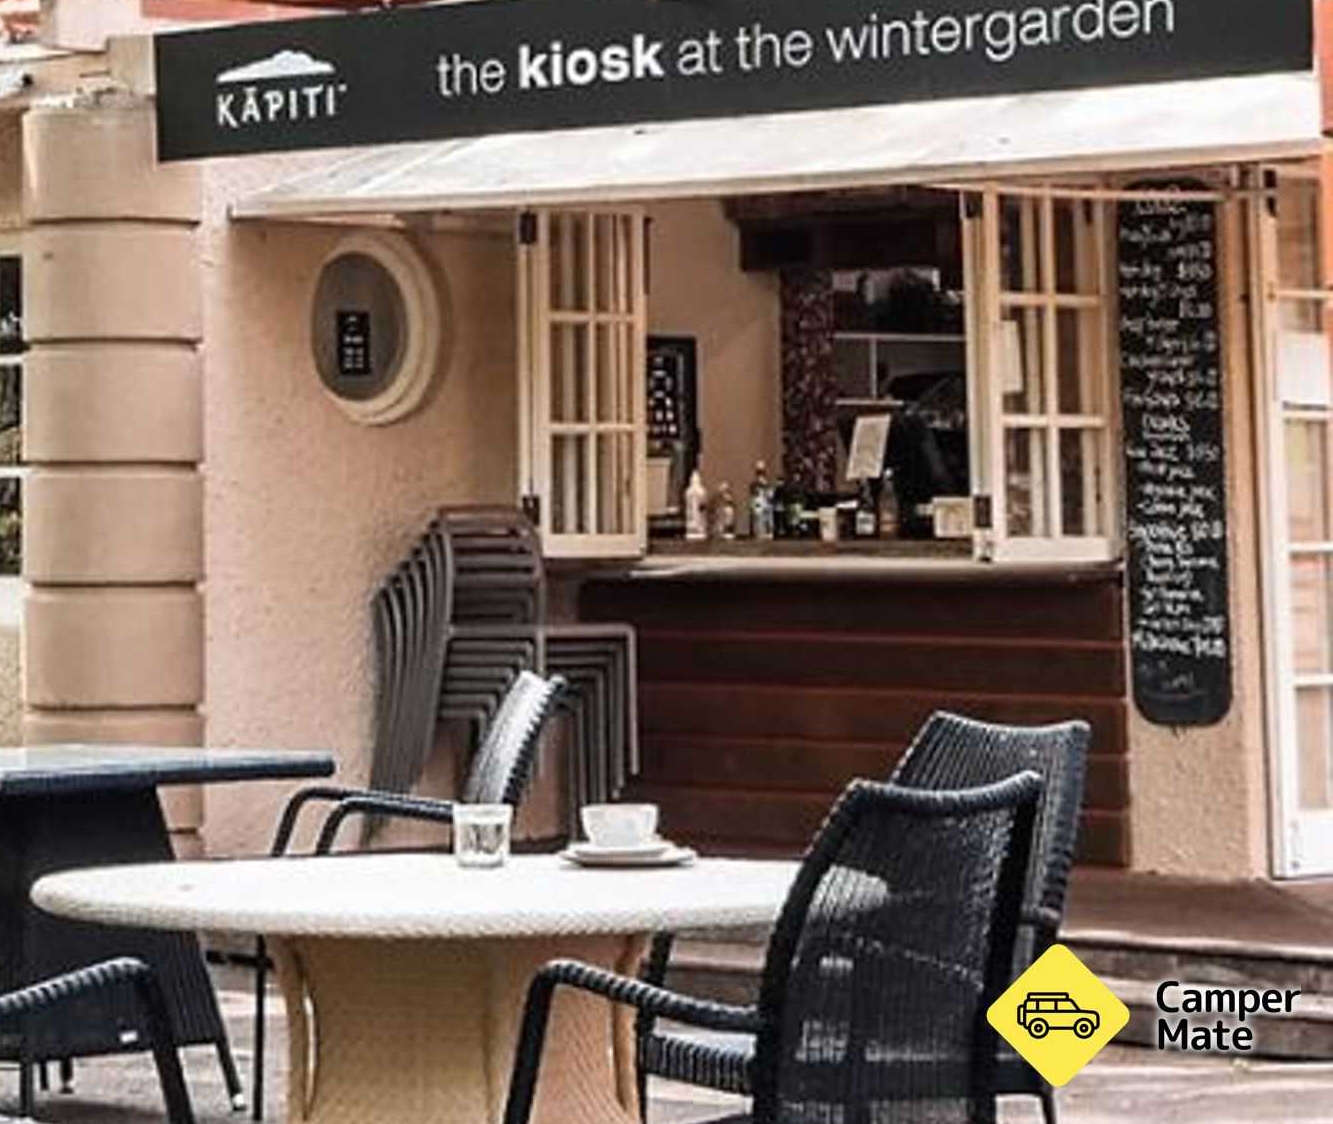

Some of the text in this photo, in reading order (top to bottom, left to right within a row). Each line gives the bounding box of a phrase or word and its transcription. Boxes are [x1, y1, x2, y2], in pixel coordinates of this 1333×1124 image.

[436, 53, 506, 97] the
[518, 34, 665, 89] kiosk
[678, 30, 723, 75] at
[735, 23, 812, 70] the
